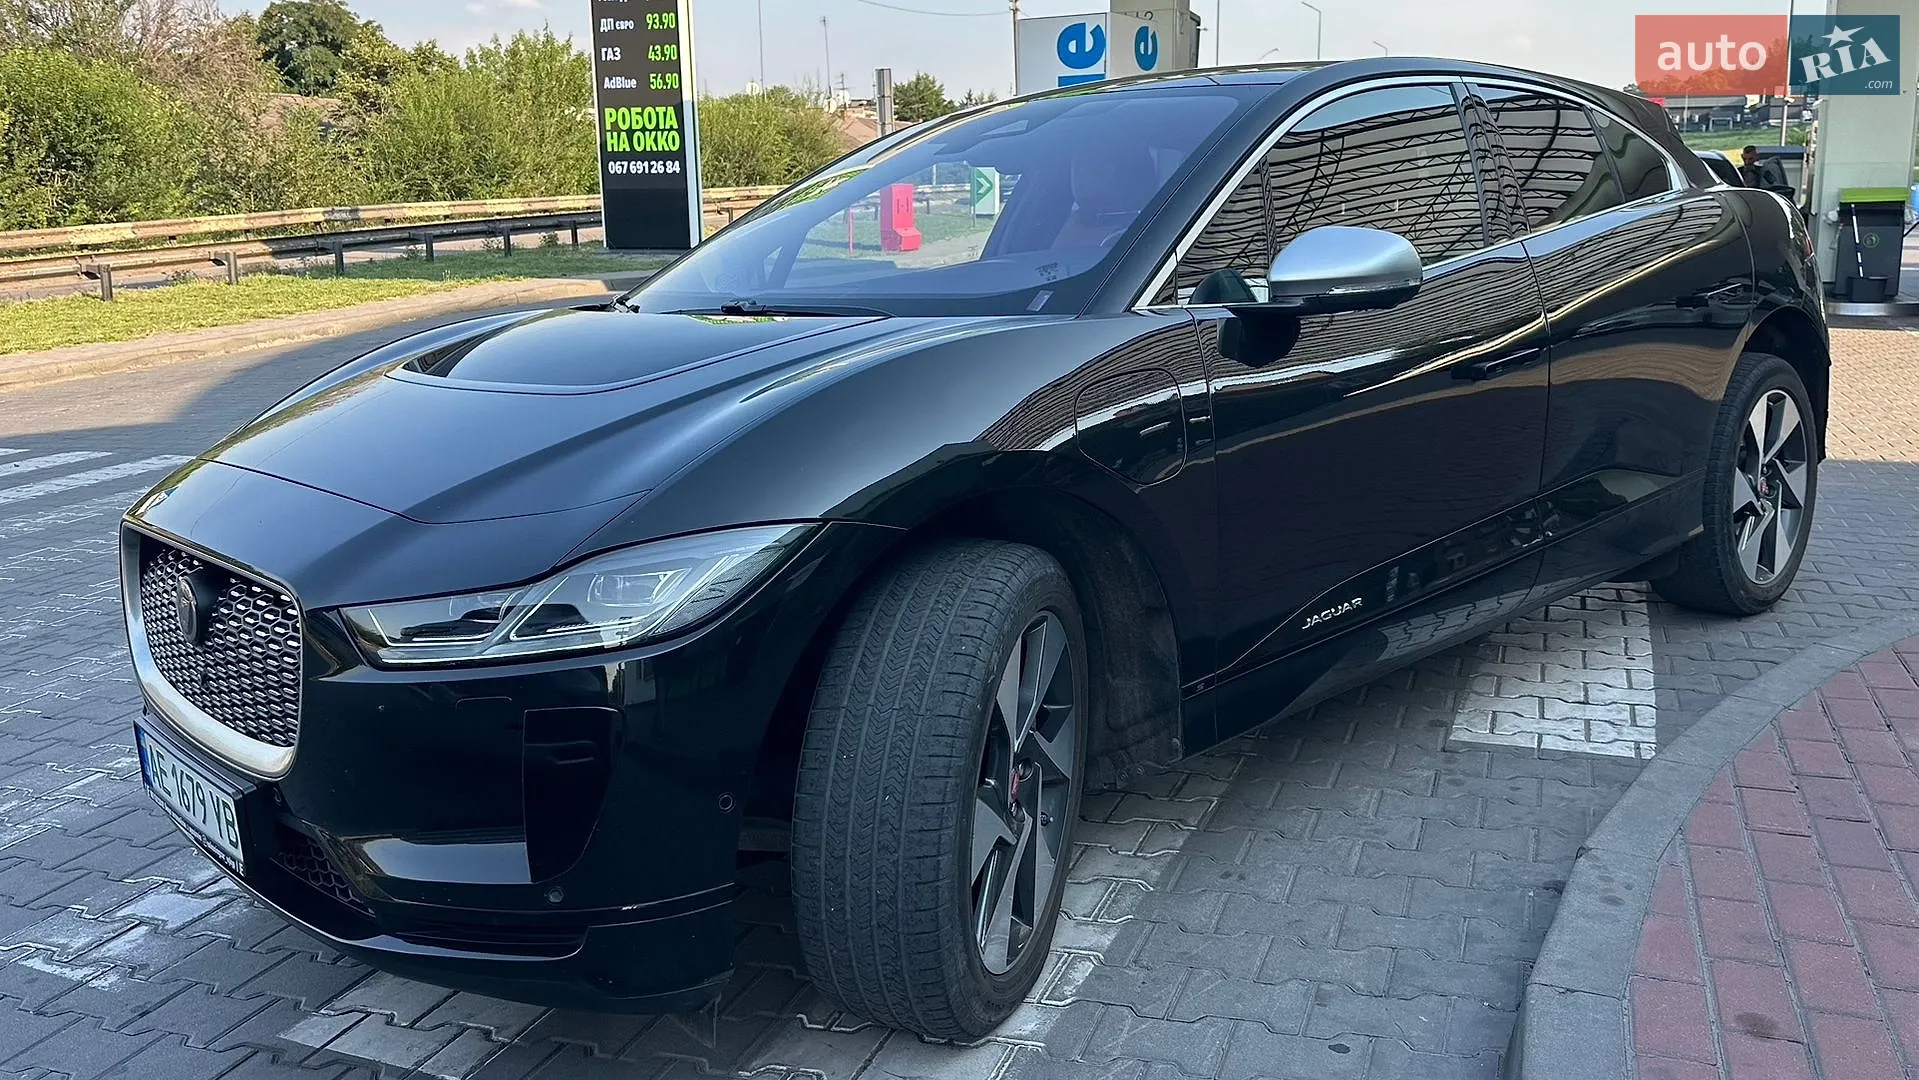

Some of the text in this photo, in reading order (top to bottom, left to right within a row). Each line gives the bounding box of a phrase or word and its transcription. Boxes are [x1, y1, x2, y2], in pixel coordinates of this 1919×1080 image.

[600, 18, 614, 32] ДП
[646, 12, 676, 30] 93.90
[601, 44, 678, 61] ГАЗ 43.90
[603, 73, 679, 90] AdBlue 56.90
[604, 106, 678, 130] РОБОТА
[606, 130, 680, 152] НА ОККО
[608, 160, 680, 174] 067 691 26 84
[1302, 597, 1363, 630] JAGUAR
[150, 745, 171, 797] AE
[171, 763, 207, 825] 1679
[209, 790, 239, 849] YB
